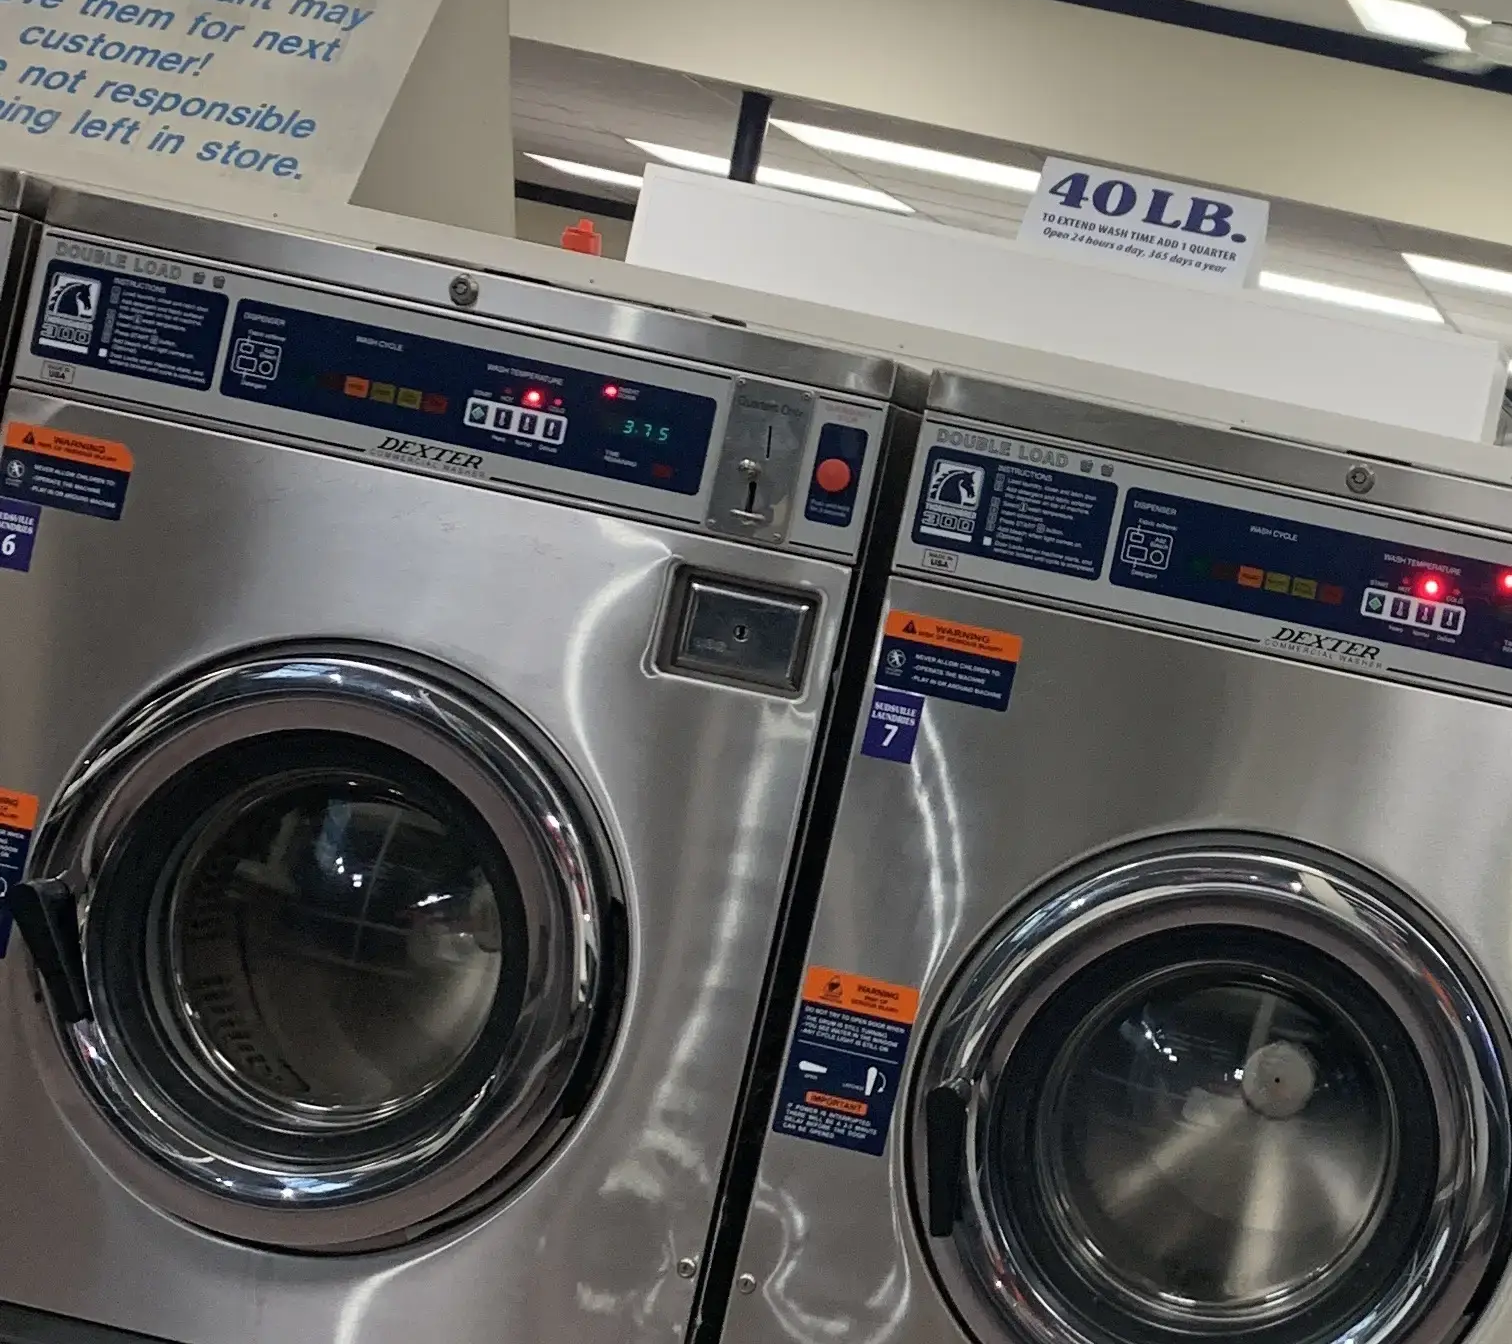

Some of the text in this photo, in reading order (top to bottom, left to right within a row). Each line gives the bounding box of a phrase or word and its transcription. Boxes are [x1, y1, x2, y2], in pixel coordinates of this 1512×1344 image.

[20, 26, 214, 76] customer!
[187, 12, 245, 42] for
[252, 31, 340, 62] next
[18, 66, 316, 138] not responsible
[69, 110, 140, 144] left
[147, 126, 184, 154] in
[196, 142, 302, 180] store.
[1049, 173, 1246, 242] 40 LB.
[1043, 213, 1055, 222] TO
[1058, 216, 1095, 230] EXTEND
[1099, 224, 1128, 238] WASH
[1131, 232, 1154, 244] TIME
[1157, 238, 1178, 248] ADD
[1190, 244, 1236, 261] QUARTER
[1043, 227, 1069, 238] Open
[1071, 233, 1084, 242] 24
[1086, 236, 1114, 249] hours
[1149, 250, 1168, 260] 365
[1170, 254, 1193, 266] days
[1203, 263, 1226, 273] year
[56, 240, 182, 281] DOUBLE LOAD
[377, 436, 485, 470] DEXTER
[937, 427, 1069, 468] DOUBLE LOAD
[998, 464, 1052, 482] INSTRUCTIONS
[1134, 500, 1176, 515] DISPENSER
[1, 533, 17, 556] 6
[1250, 526, 1298, 541] WASH CYCLE
[1384, 554, 1461, 576] WASH TEMPERATURE
[935, 626, 990, 643] WARNING
[1272, 627, 1381, 661] DEXTER
[1264, 638, 1383, 670] COMMERCIAL WASHER
[881, 724, 899, 747] 7
